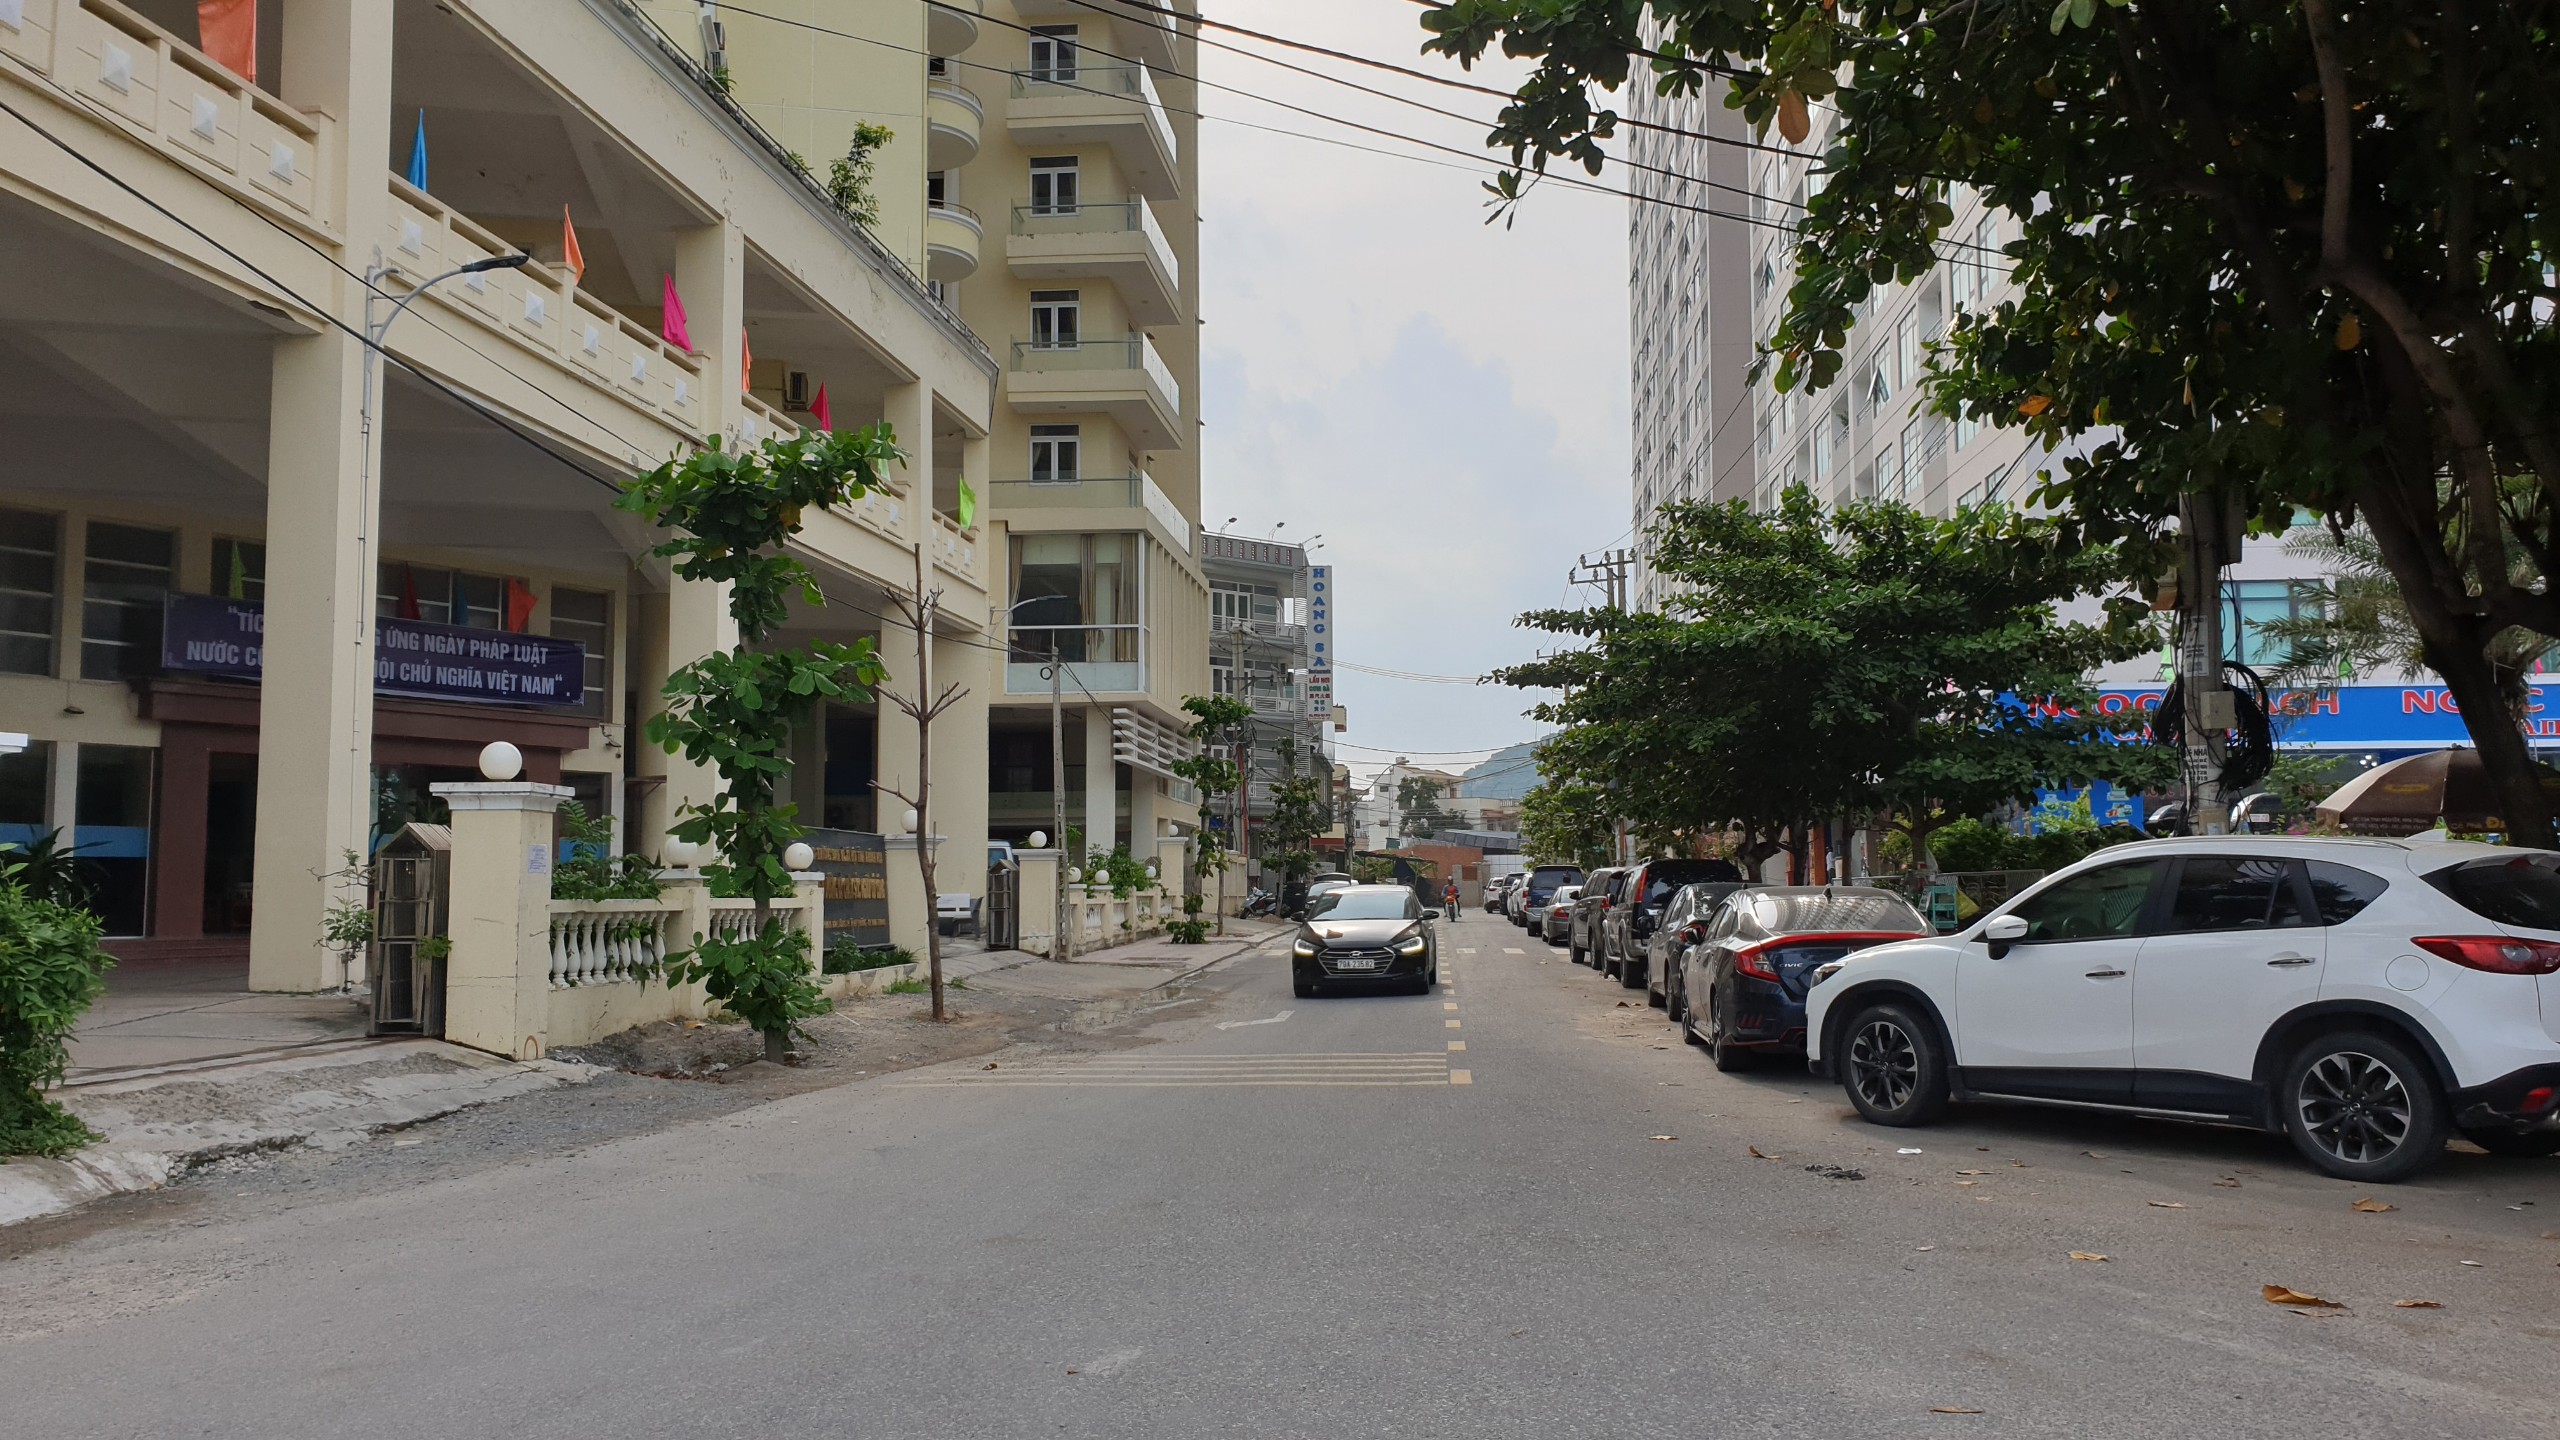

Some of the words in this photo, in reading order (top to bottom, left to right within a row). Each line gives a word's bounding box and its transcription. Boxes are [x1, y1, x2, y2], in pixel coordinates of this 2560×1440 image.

[1313, 568, 1325, 634] HOANG
[186, 639, 240, 665] NƯỚC
[400, 659, 431, 684] CHỦ
[436, 666, 483, 689] NGHĨA
[487, 669, 518, 694] VIỆT
[386, 626, 419, 650] ỨNG
[424, 633, 465, 655] NGÀY
[470, 638, 510, 660] PHÁP
[513, 642, 549, 667] LUẬT
[1313, 642, 1325, 667] SA
